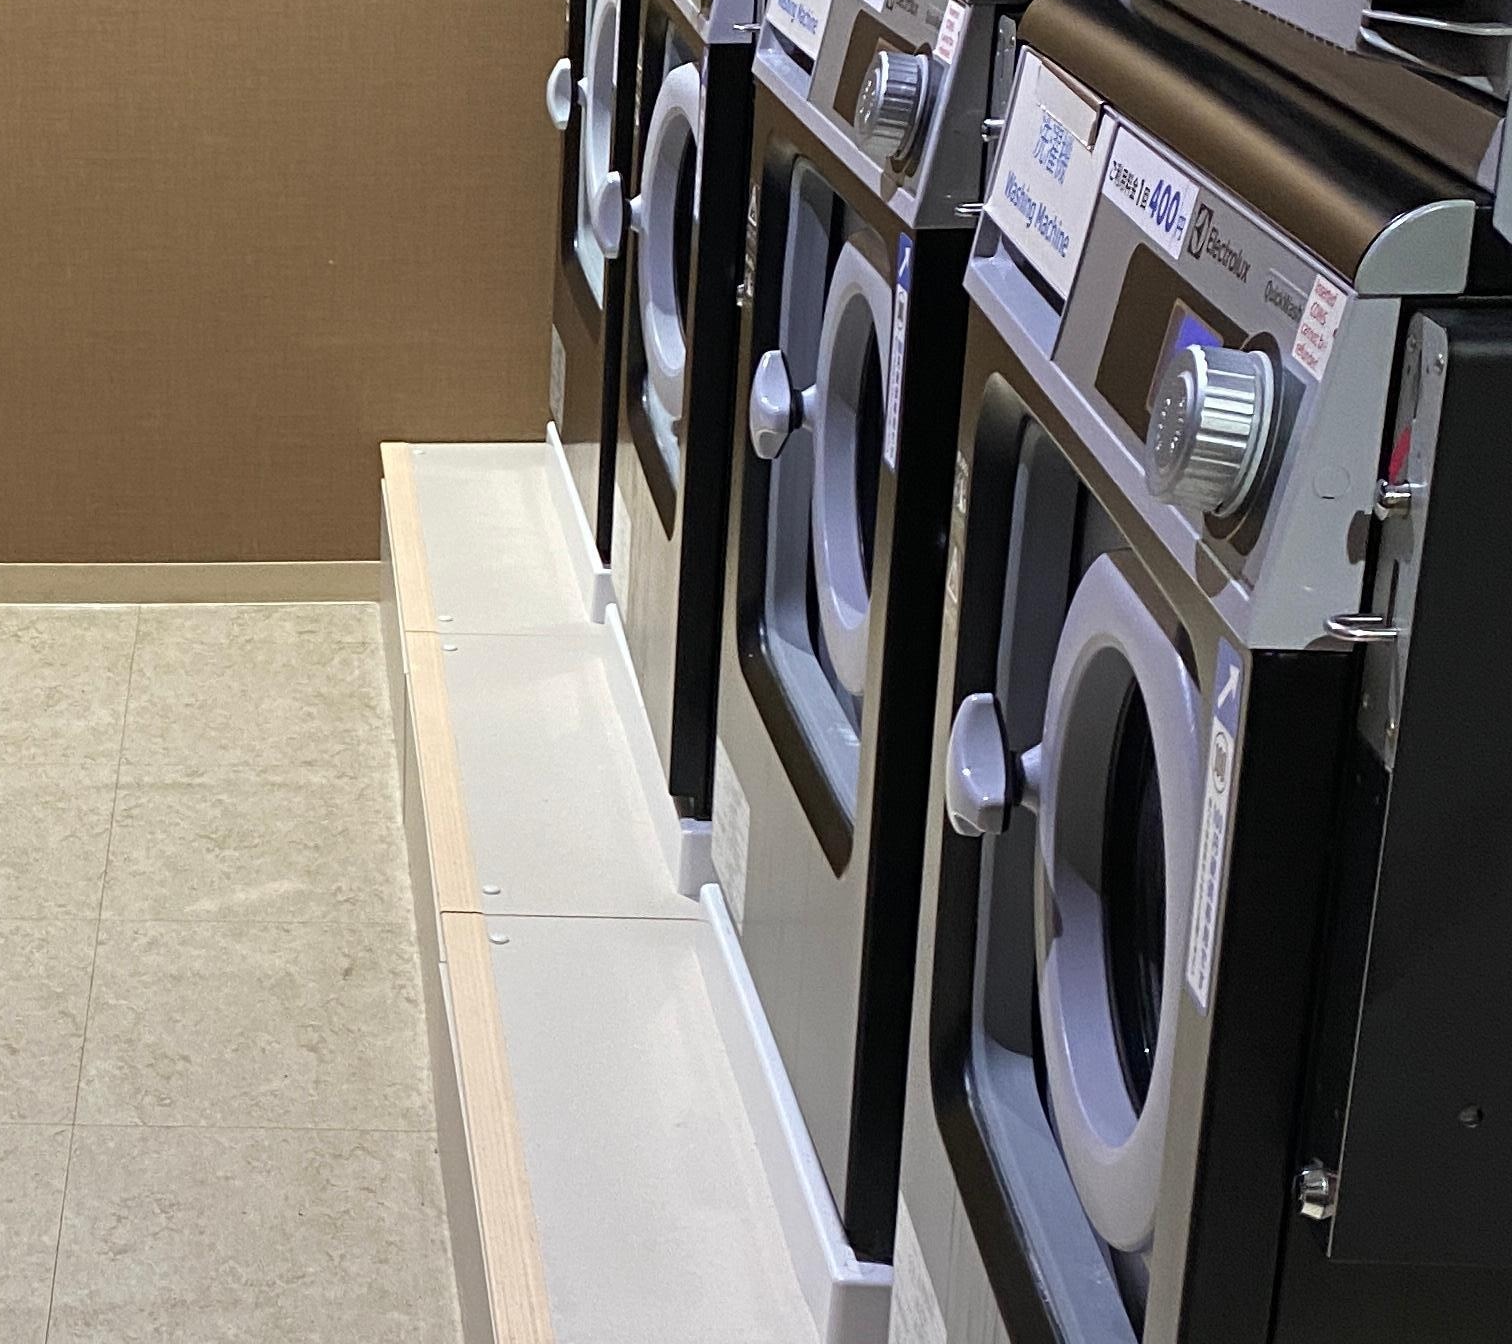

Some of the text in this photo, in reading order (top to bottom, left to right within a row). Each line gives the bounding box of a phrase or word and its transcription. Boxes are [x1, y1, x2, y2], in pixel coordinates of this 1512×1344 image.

[1004, 169, 1070, 258] Washing Machine
[1206, 226, 1251, 284] Electrolux
